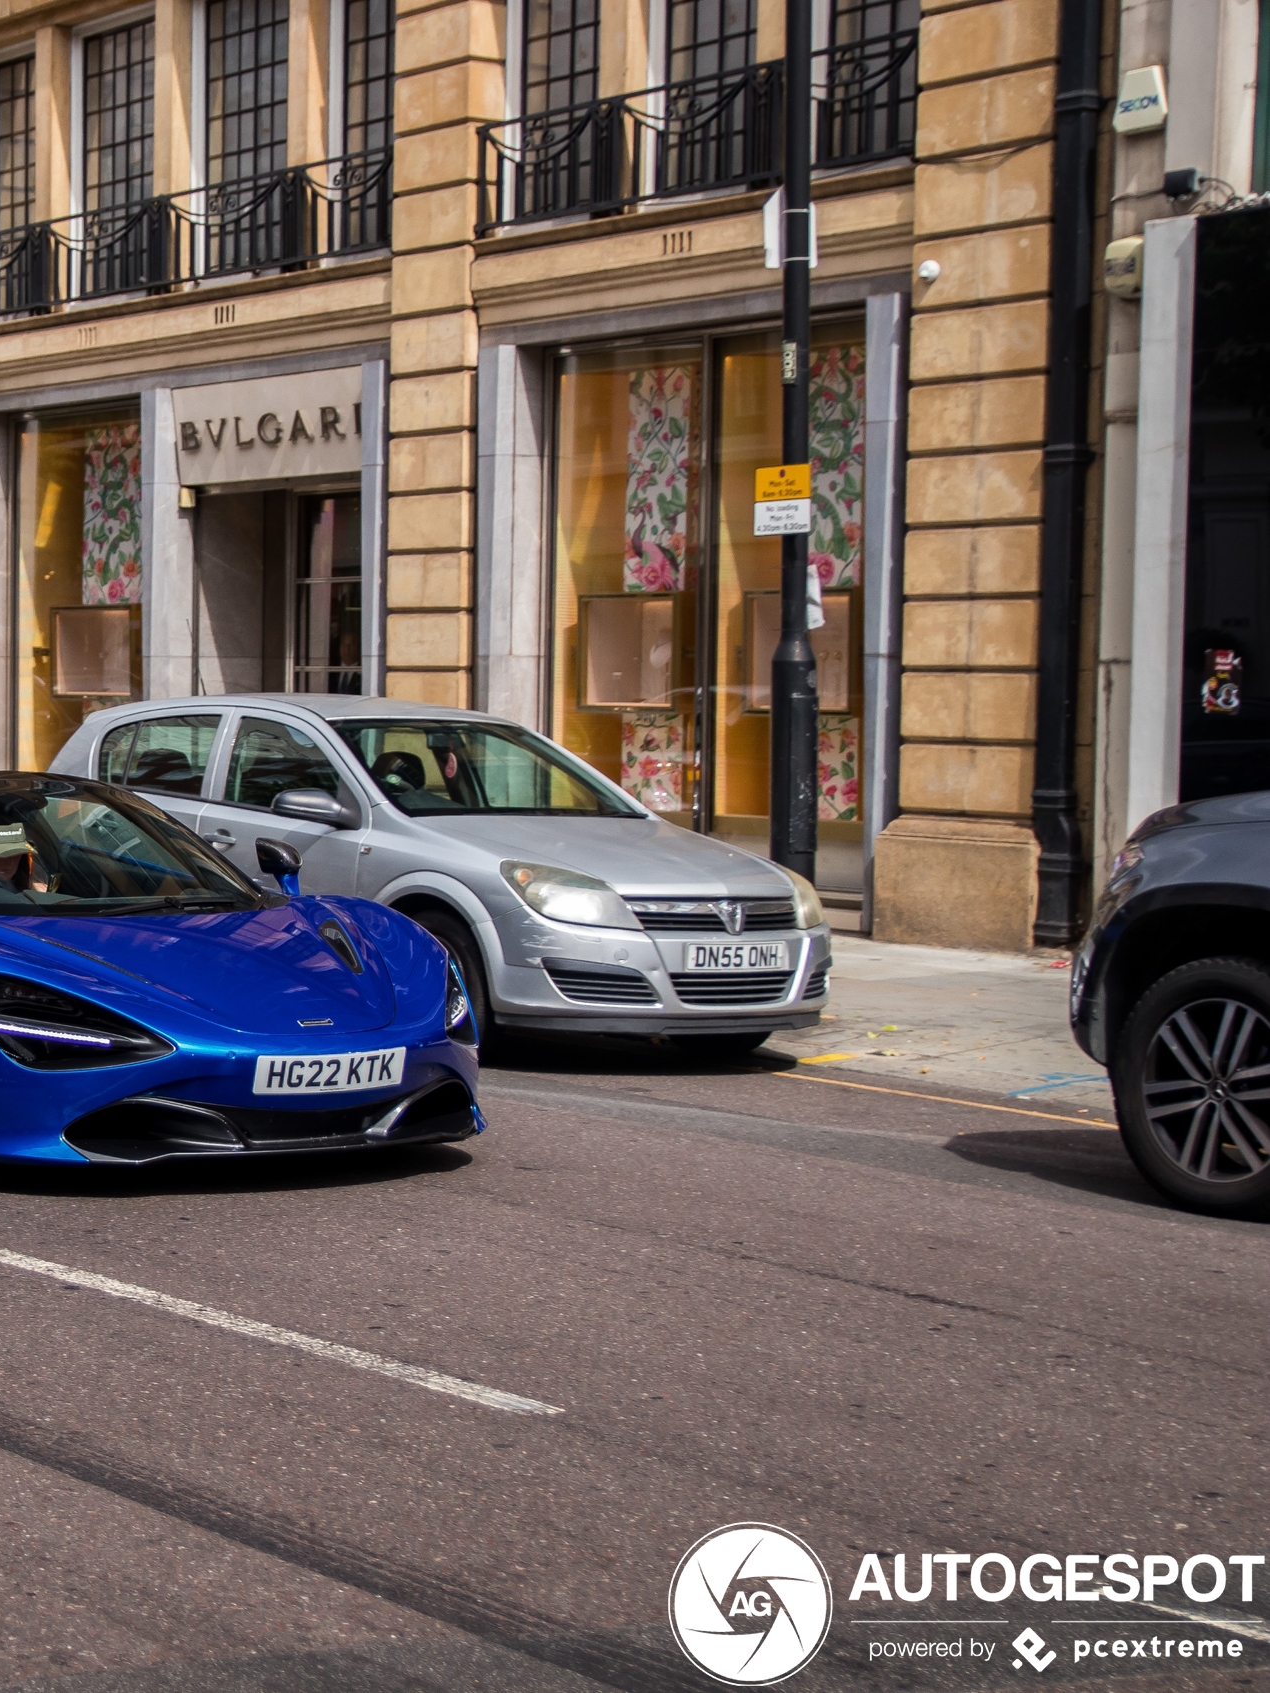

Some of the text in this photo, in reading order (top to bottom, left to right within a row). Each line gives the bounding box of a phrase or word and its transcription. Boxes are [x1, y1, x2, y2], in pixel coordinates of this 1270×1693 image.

[180, 402, 362, 451] BVLGARI
[695, 945, 779, 968] DN55 ONH
[266, 1052, 396, 1088] HG22 KTK
